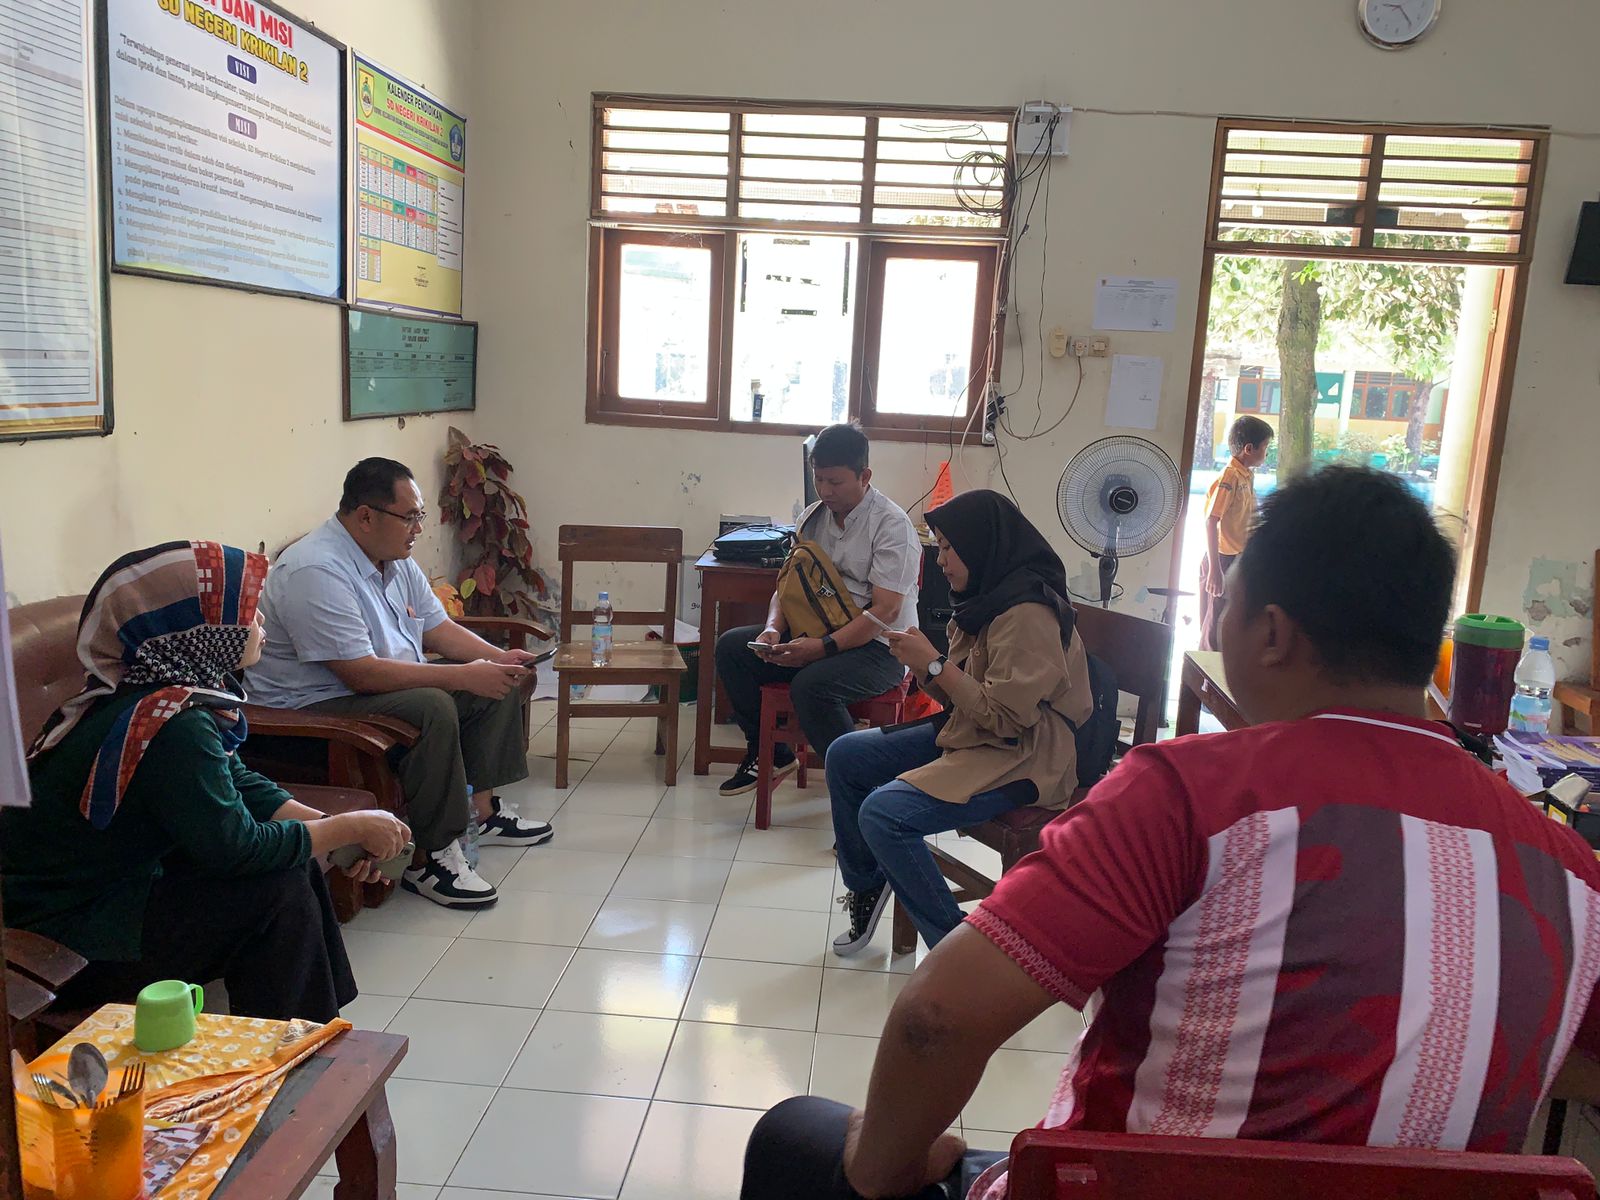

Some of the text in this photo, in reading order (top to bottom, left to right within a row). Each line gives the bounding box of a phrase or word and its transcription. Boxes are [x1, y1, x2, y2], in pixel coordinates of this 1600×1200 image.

[222, 0, 293, 48] DAN MISI
[184, 0, 237, 46] NEGERI
[240, 28, 298, 77] KRIKILAN
[299, 61, 309, 83] 2
[155, 66, 166, 77] dan
[190, 67, 205, 80] yang
[234, 60, 250, 79] VISI
[386, 97, 395, 111] SD
[395, 103, 415, 121] NEGERI
[387, 81, 443, 122] KALENDER PENDIDIKAN
[235, 117, 251, 135] MISI
